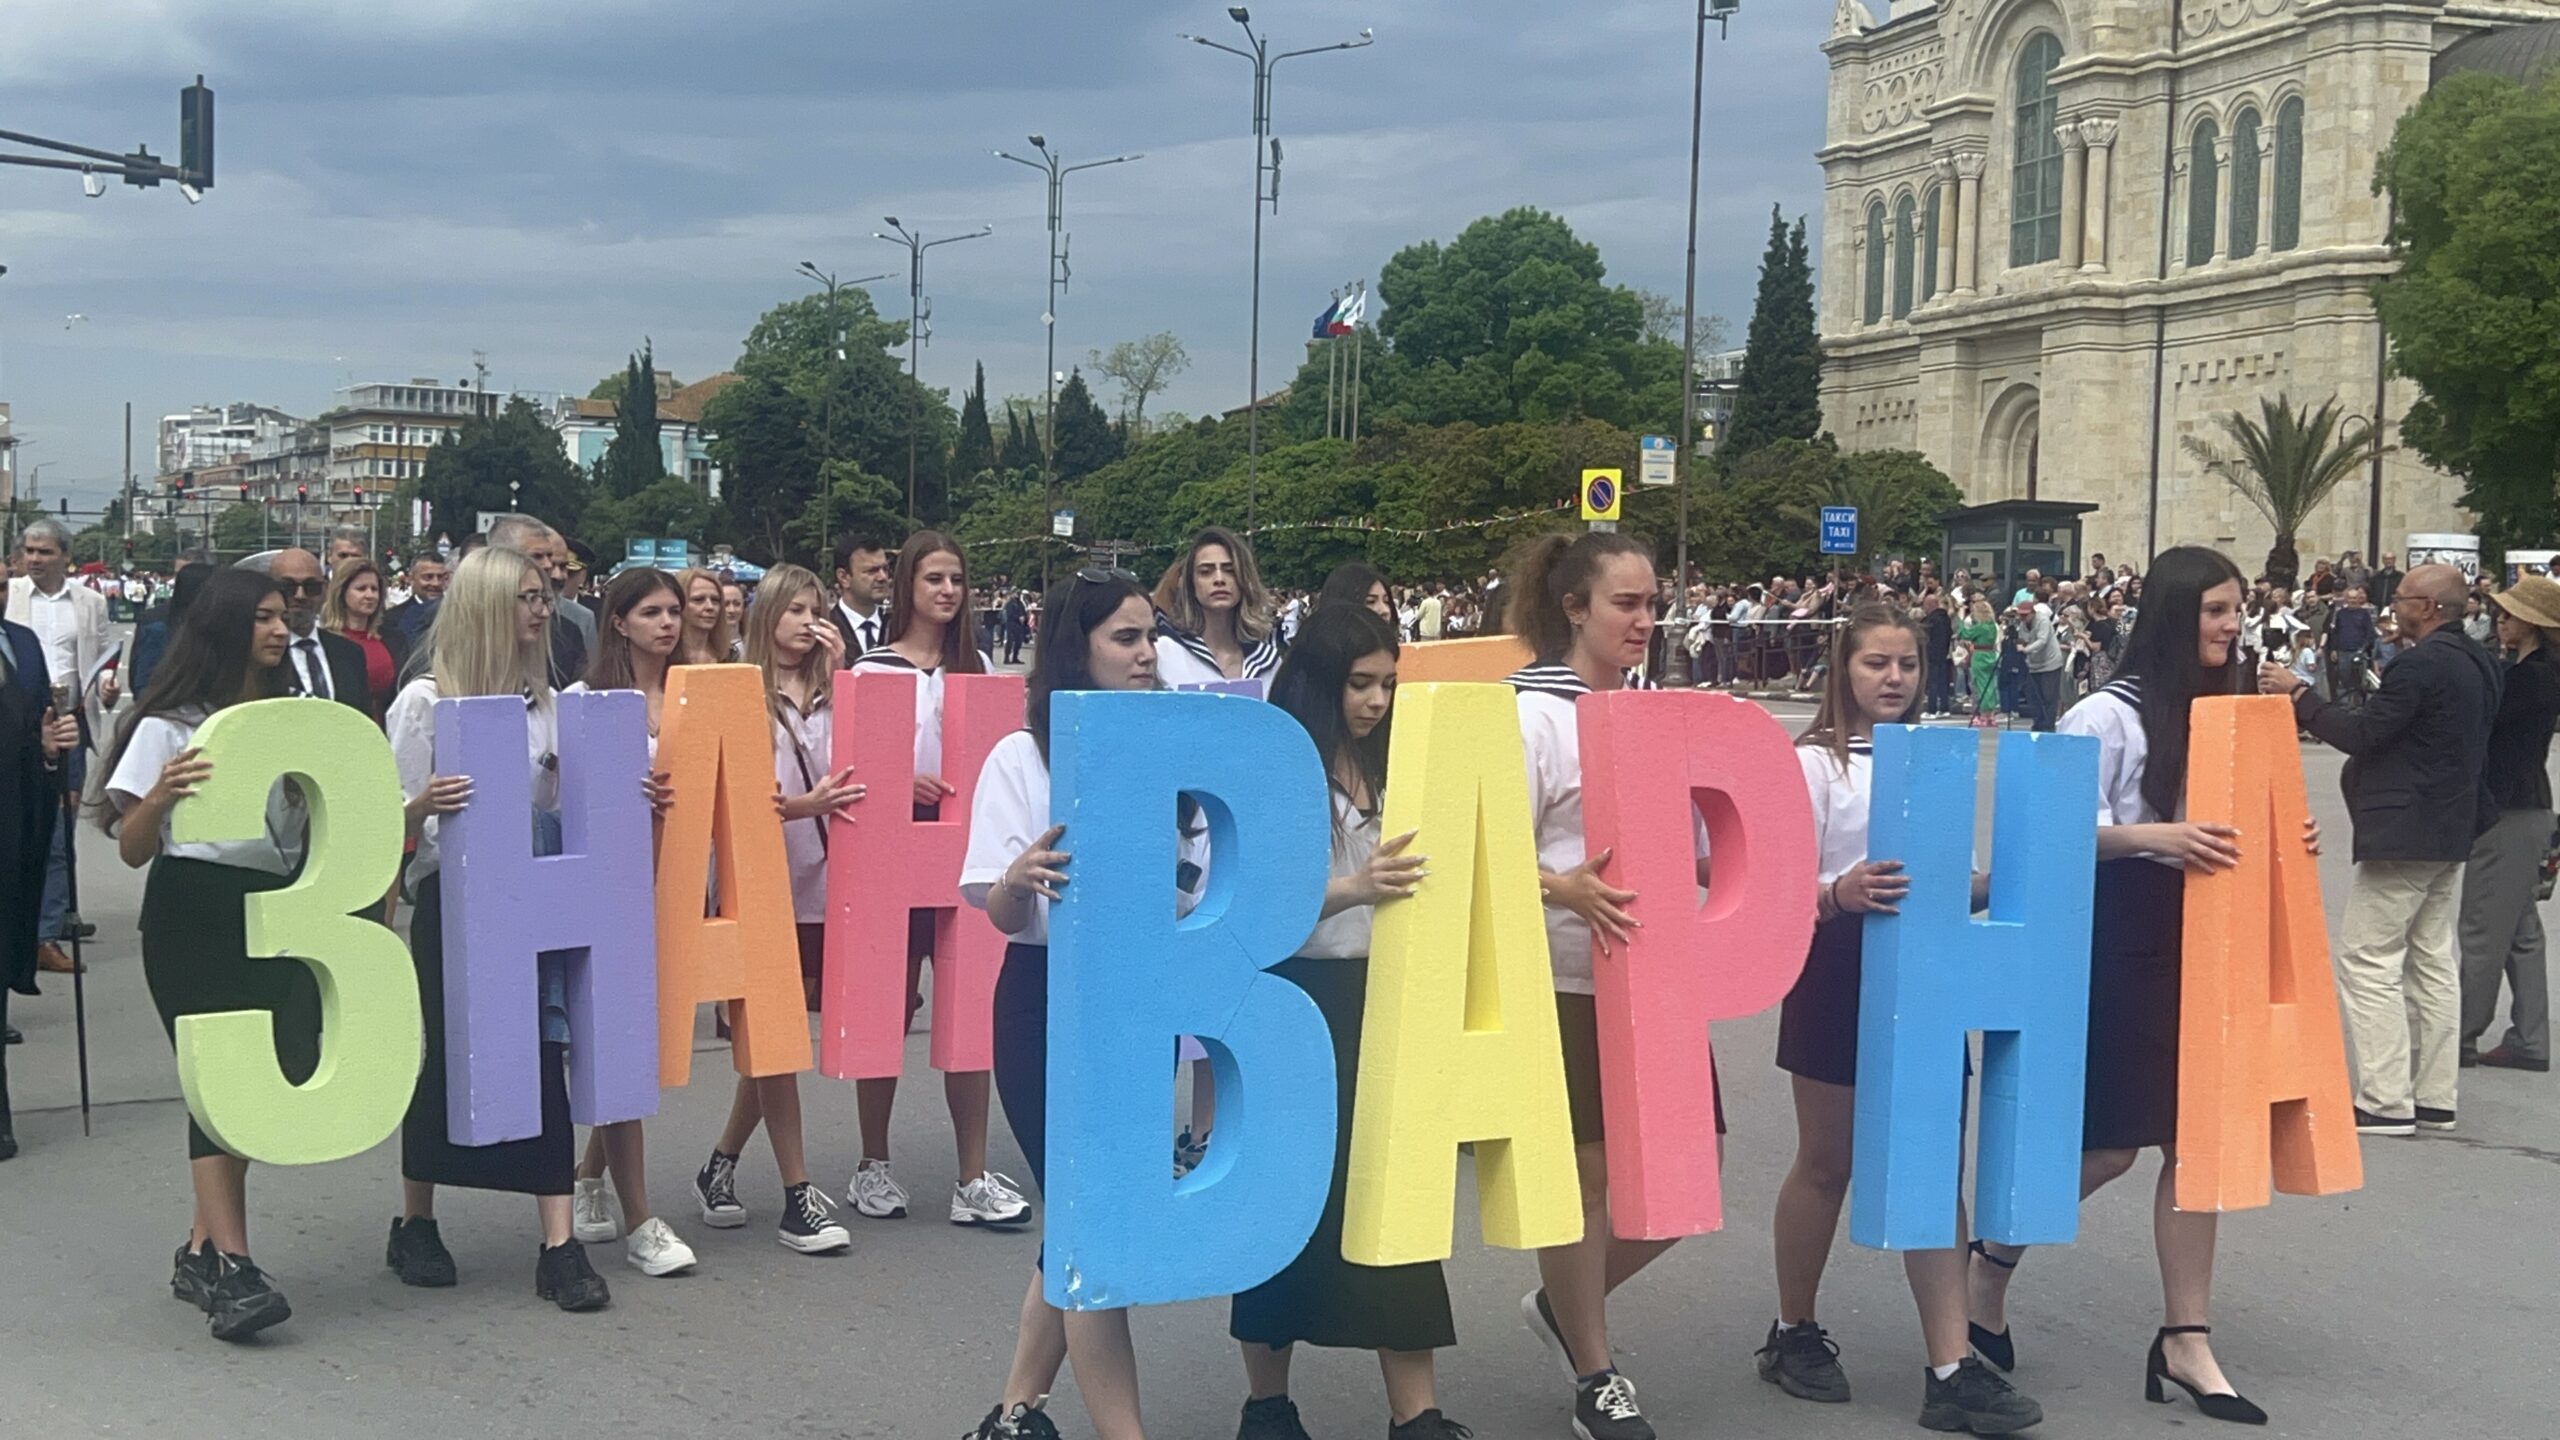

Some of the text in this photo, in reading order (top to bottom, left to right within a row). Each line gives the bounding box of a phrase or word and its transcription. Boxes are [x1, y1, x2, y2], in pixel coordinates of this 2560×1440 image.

[1824, 512, 1856, 523] ТАКСИ
[1828, 526, 1850, 537] TAXI
[1043, 681, 2367, 1313] ВАРНА
